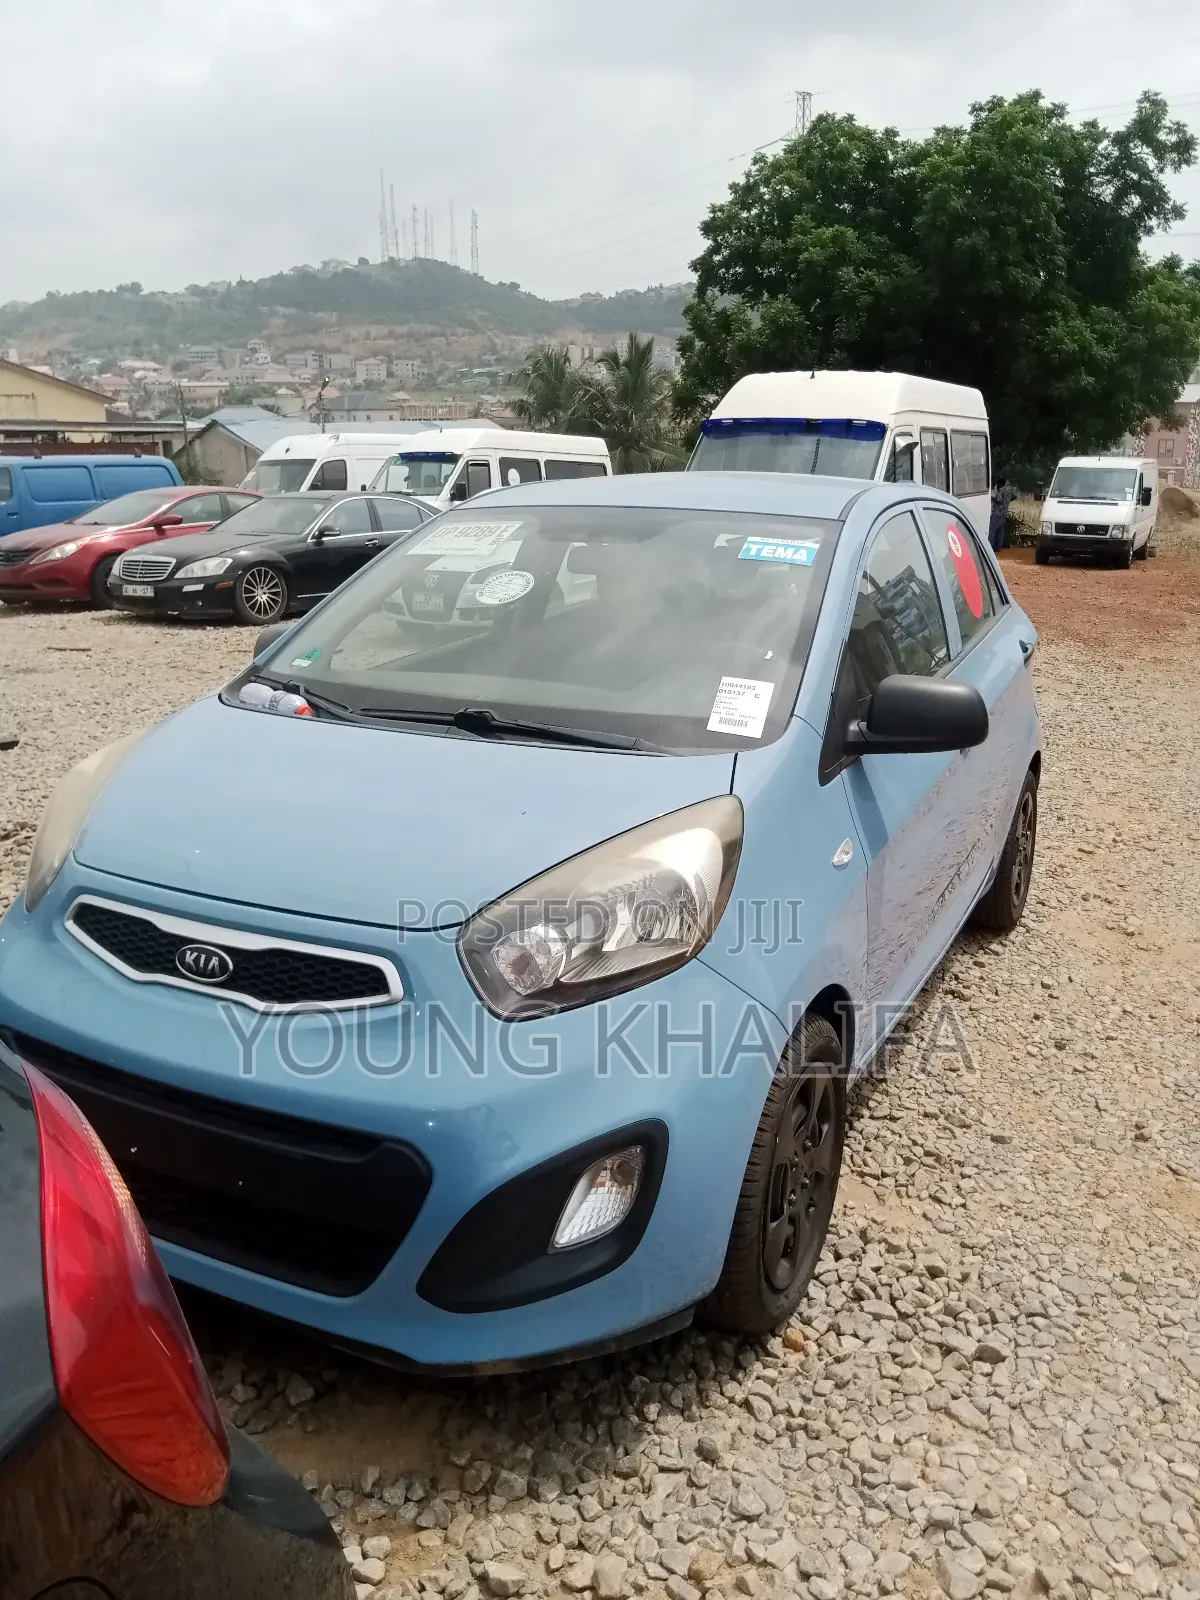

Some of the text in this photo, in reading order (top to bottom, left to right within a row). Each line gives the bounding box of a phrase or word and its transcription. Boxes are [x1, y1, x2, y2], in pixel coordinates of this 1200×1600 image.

[432, 526, 457, 538] DP
[454, 525, 501, 538] 9289
[748, 544, 808, 562] TEMA
[185, 950, 221, 977] KIA
